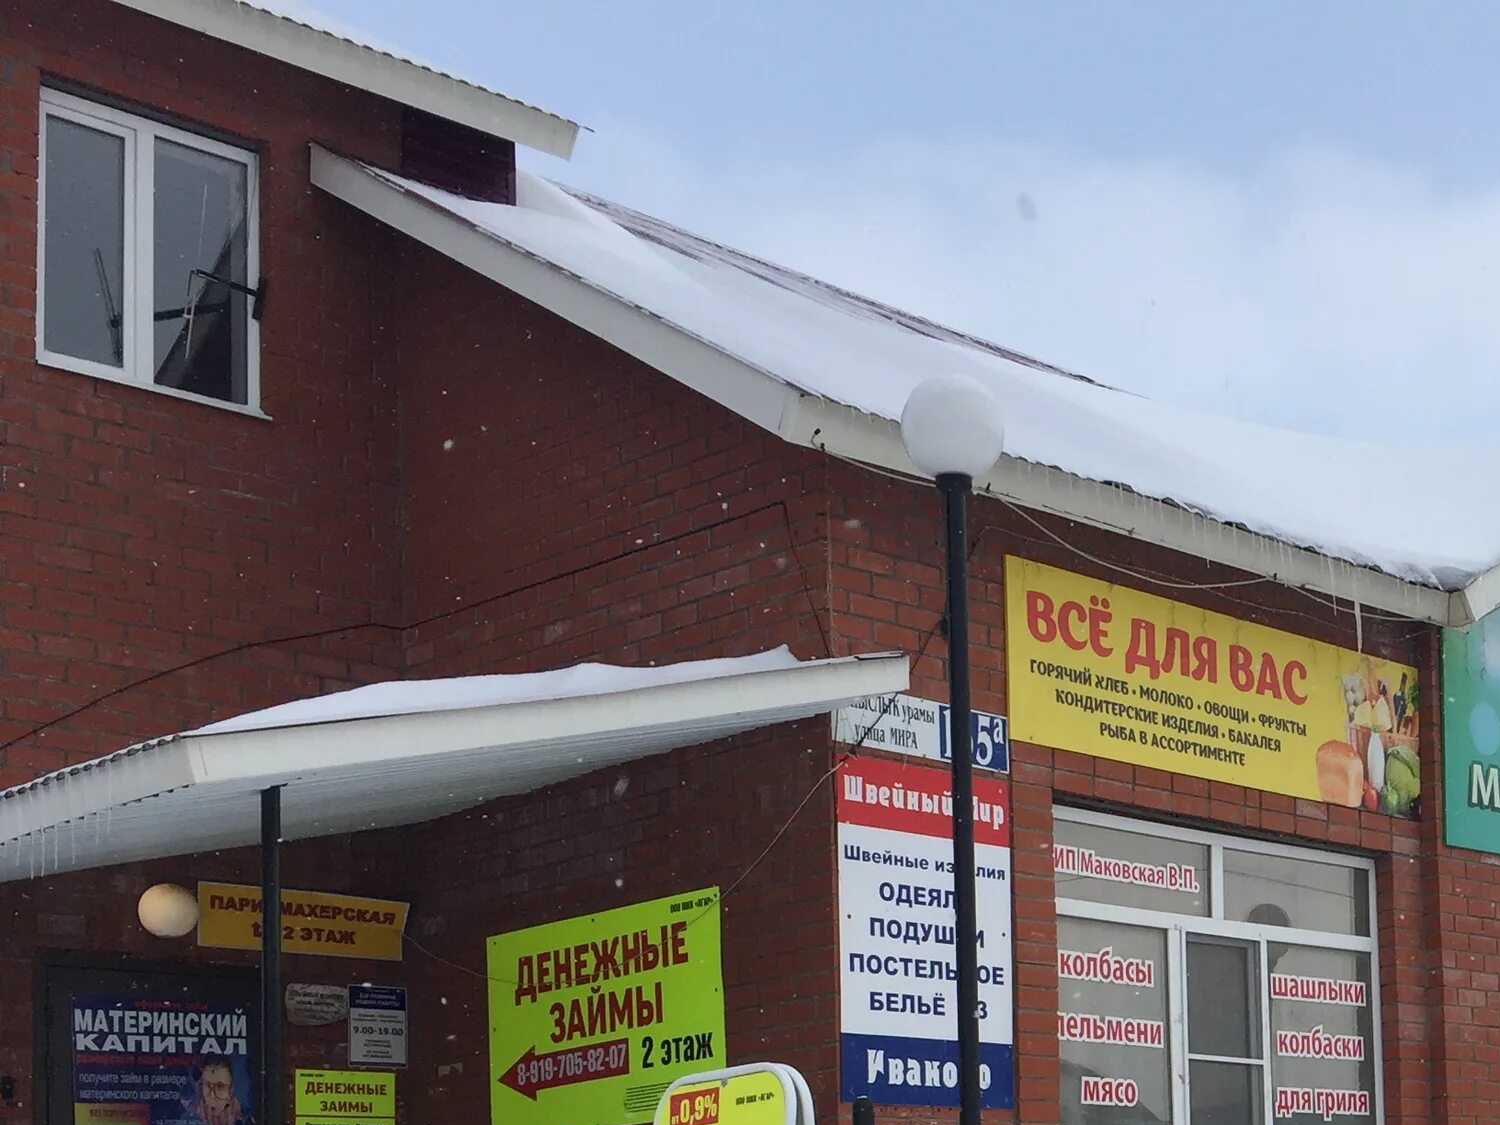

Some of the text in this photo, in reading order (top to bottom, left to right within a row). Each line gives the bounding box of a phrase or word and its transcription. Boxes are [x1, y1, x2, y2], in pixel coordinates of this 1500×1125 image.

[1026, 590, 1309, 705] ВСЁ ДЛЯ ВАС
[902, 704, 935, 724] урамы
[1030, 658, 1308, 738] ГОРЯЧИЙ ХЛЕБ МОЛОКО ОВОЩИ ФРУКТЫ
[1055, 687, 1282, 753] КОНДИТЕРСКИЕ ИЗДЕЛИЯ БАКАЛЕЯ
[890, 727, 918, 749] МИРА
[1099, 721, 1246, 767] РЫБА В АССОРТИМЕНТЕ
[843, 774, 953, 816] Швейный
[844, 844, 1006, 881] Швейные излия
[1054, 847, 1200, 892] ИП Маковская В.П.
[210, 894, 396, 925] ПАРИМАХЕРСКАЯ
[283, 926, 355, 944] 2 ЭТАЖ
[869, 917, 985, 949] ПОДУШИ
[515, 921, 689, 1006] ДЕНЕЖНЫЕ
[849, 953, 1005, 986] ПОСТЕЛЬОЕ
[1059, 947, 1153, 986] колбасы
[869, 991, 946, 1017] БЕЛЬЁ
[1272, 975, 1366, 1004] шашлыки
[74, 1008, 247, 1037] МАТЕРИНСКИЙ
[550, 982, 663, 1044] ЗАЙМЫ
[75, 1034, 247, 1055] КАПИТАЛ
[642, 1032, 714, 1069] 2 этаж
[1278, 1026, 1363, 1058] колбаски
[517, 1043, 627, 1087] 8-919-705-82-07
[867, 1048, 992, 1091] Иваноо
[305, 1082, 387, 1096] ДЕНЕЖНЫЕ
[1082, 1077, 1137, 1105] мясо
[1276, 1090, 1369, 1120] для гриля
[680, 1093, 718, 1125] 0,9%
